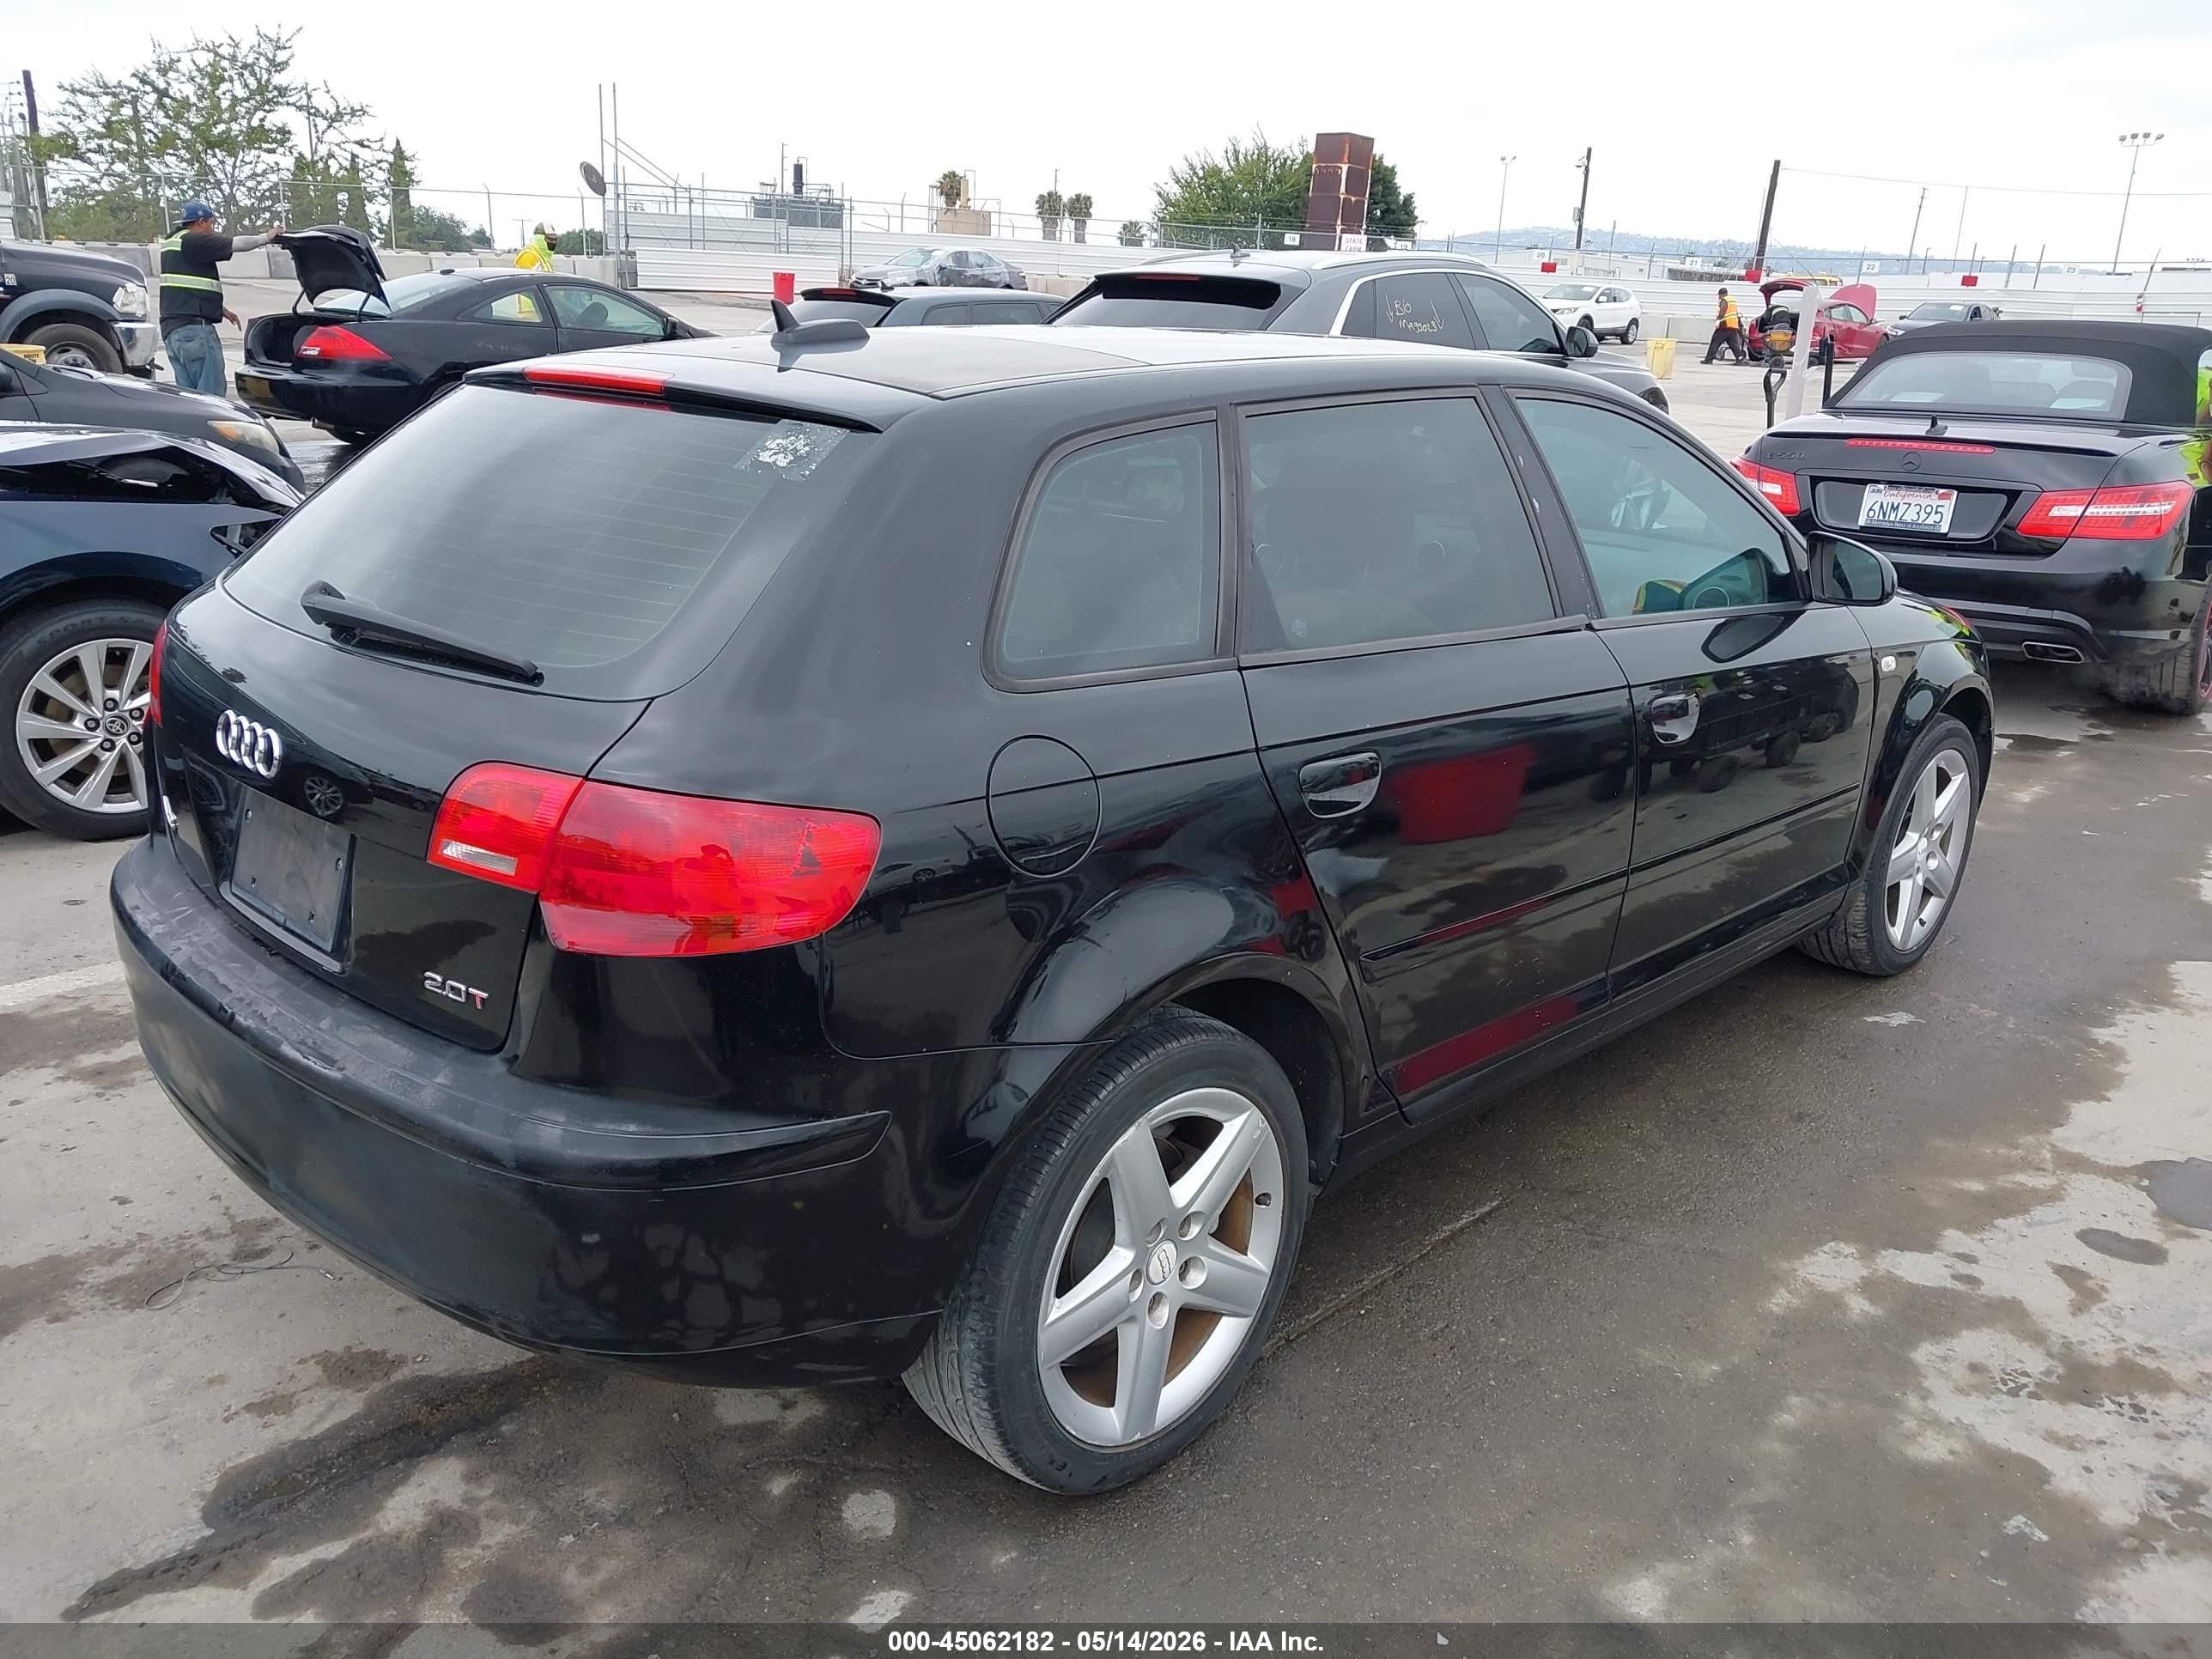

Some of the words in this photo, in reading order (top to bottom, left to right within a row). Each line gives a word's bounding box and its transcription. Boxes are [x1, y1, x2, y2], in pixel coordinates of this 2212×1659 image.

[1345, 237, 1363, 246] STATE
[5, 276, 15, 285] 20
[1883, 490, 1933, 501] California
[1866, 500, 1945, 525] 6NMZ395
